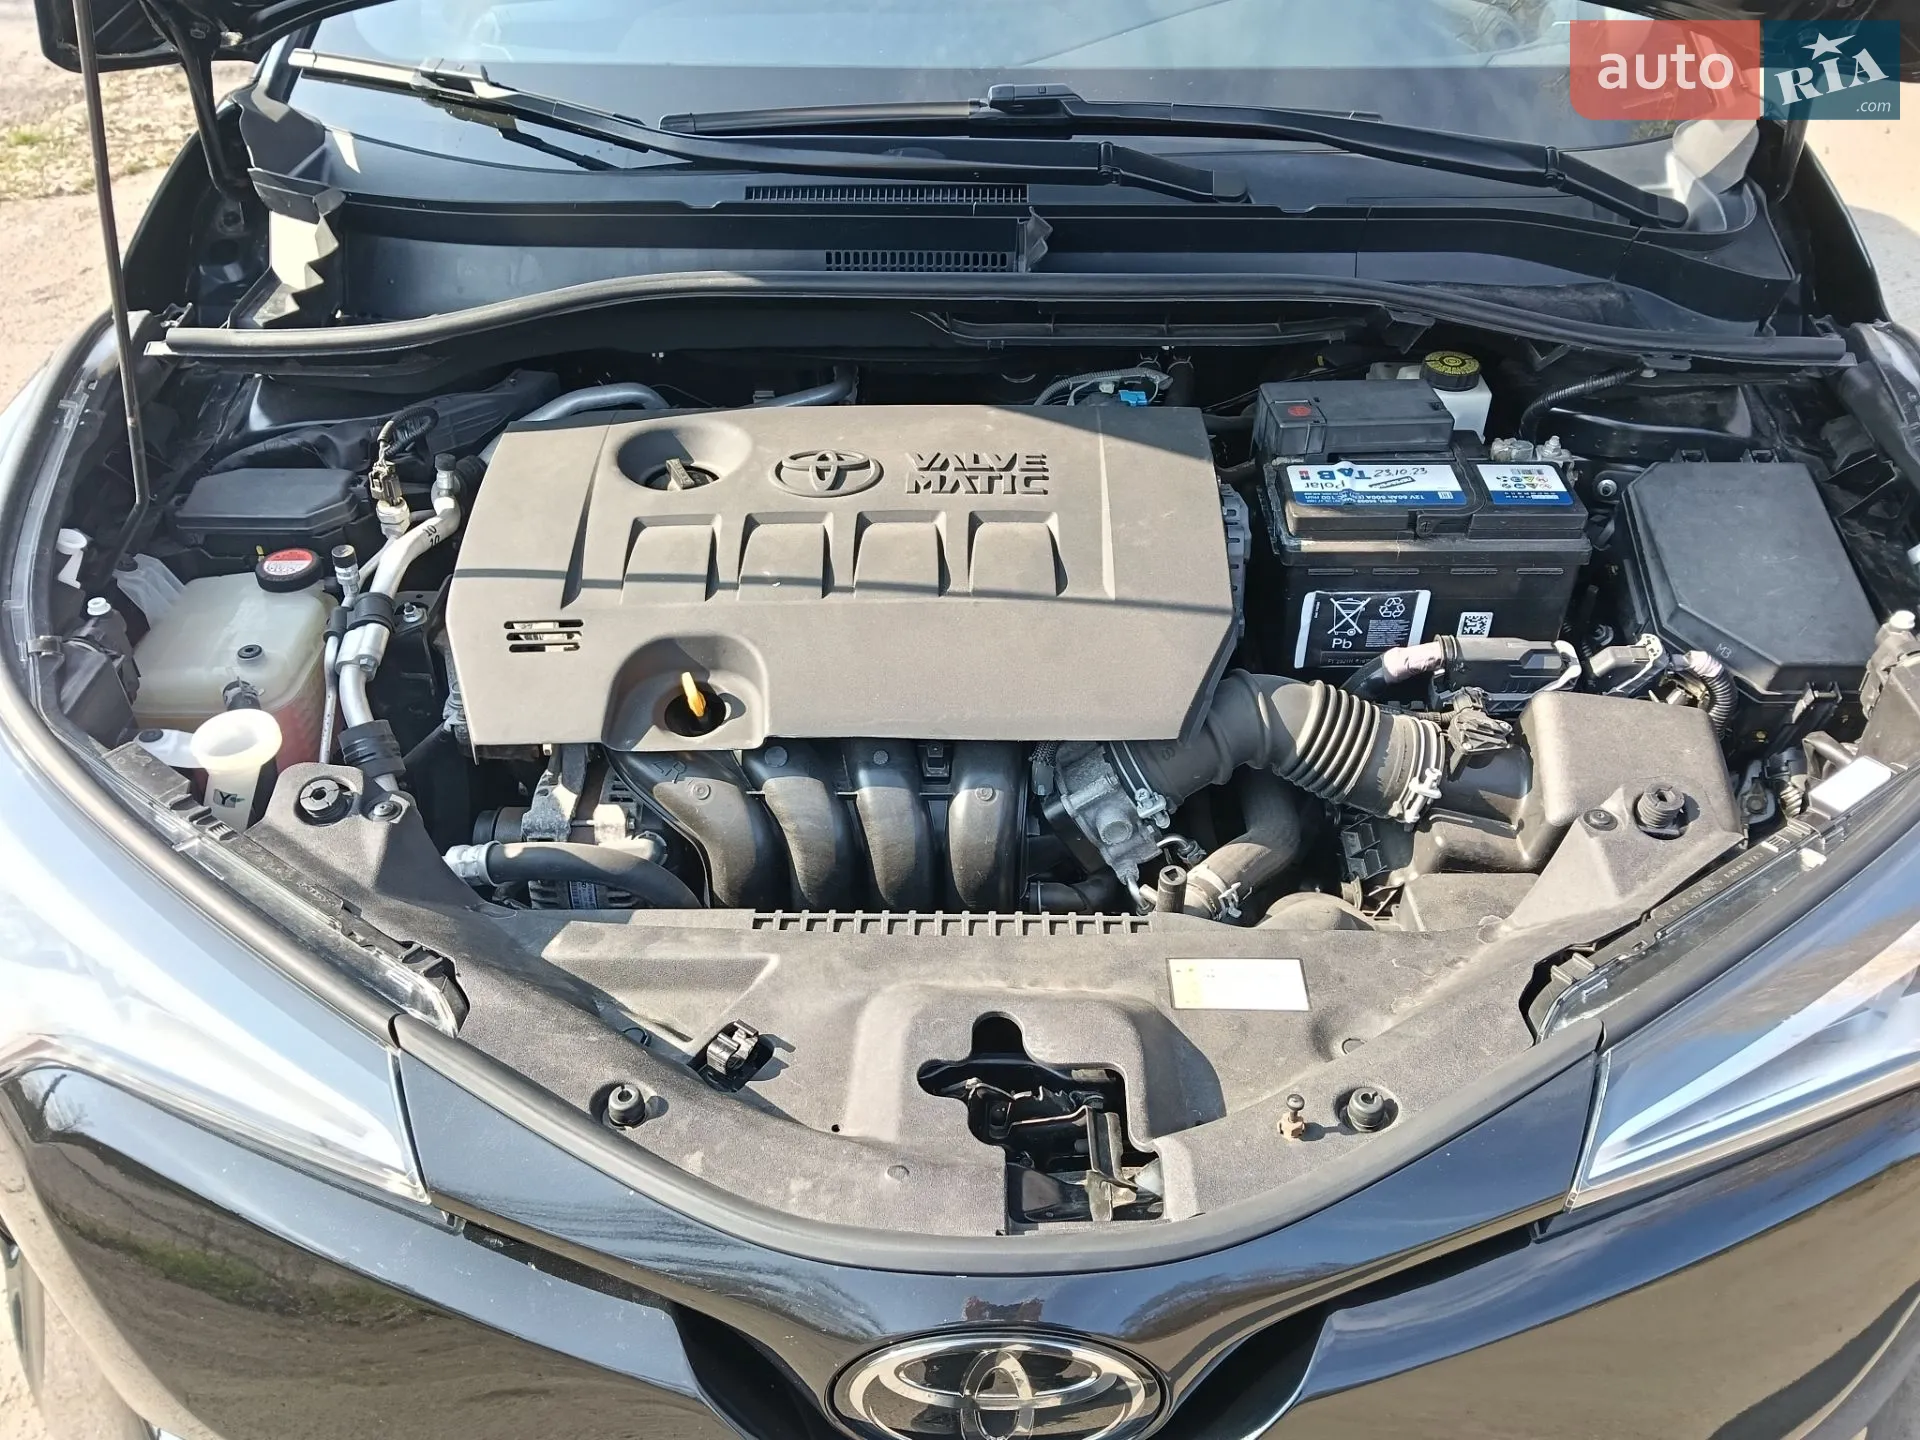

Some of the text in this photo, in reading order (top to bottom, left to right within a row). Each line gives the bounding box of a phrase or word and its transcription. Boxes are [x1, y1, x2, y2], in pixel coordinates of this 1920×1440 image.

[905, 452, 1049, 472] VALVE
[1317, 468, 1372, 480] TAB
[905, 472, 1049, 495] MATIC
[1305, 480, 1345, 489] Polar
[1332, 638, 1352, 649] Pb
